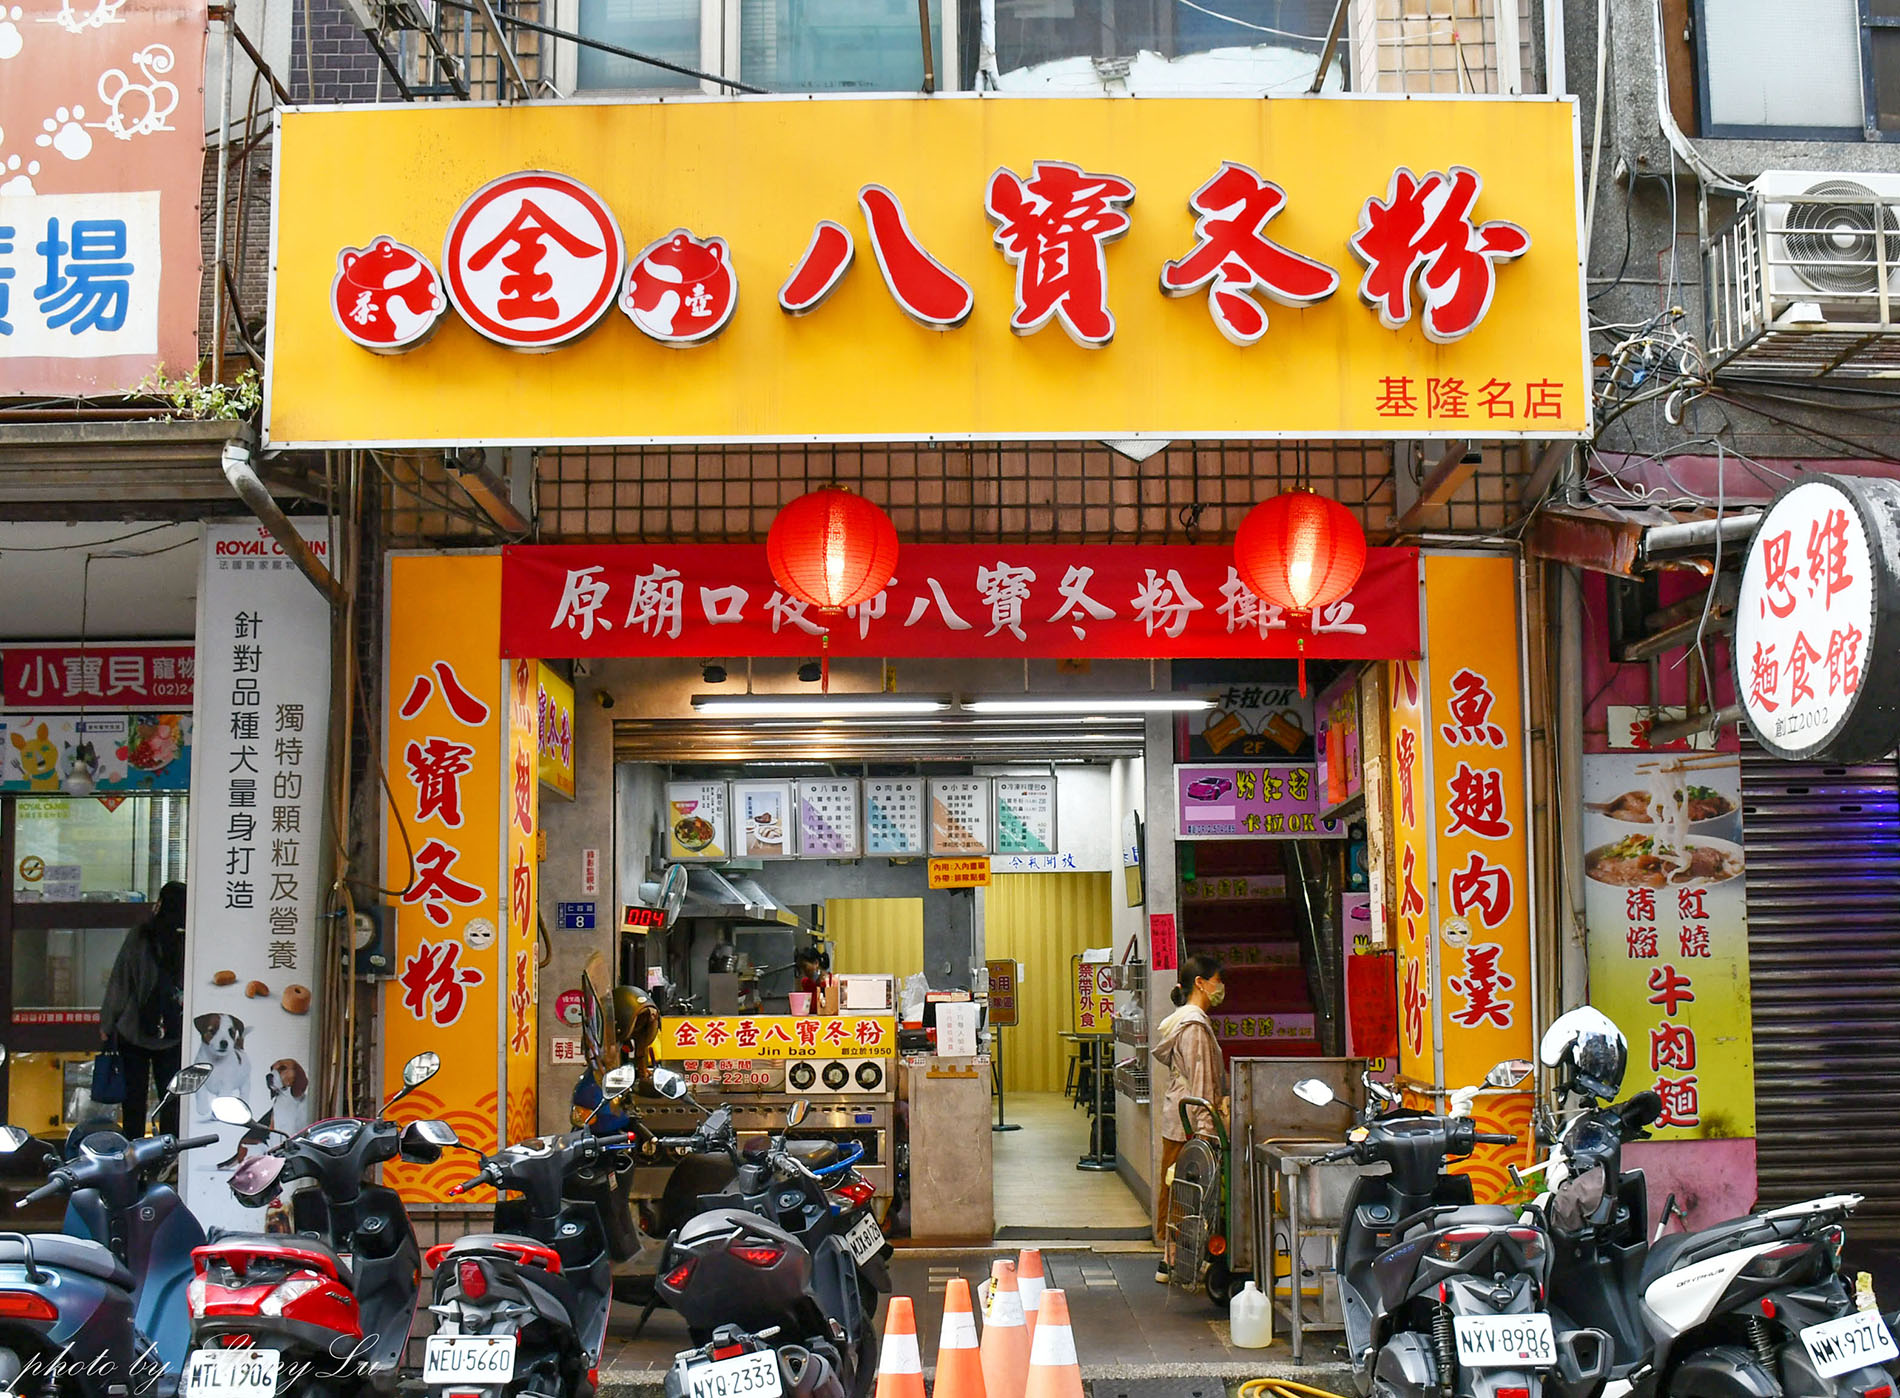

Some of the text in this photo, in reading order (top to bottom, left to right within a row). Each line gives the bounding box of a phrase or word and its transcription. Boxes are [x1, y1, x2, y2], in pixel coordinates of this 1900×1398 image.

[0, 217, 134, 336] 場
[777, 161, 1531, 346] 八寶冬粉
[349, 291, 378, 326] 茶
[1375, 375, 1564, 421] 基隆名店
[216, 541, 268, 555] ROYAL
[1760, 508, 1853, 619] 思維
[19, 656, 148, 697] 小寶貝
[1749, 622, 1862, 712] 麵食館
[1220, 687, 1295, 709] 卡拉OK
[225, 610, 263, 910] 針對品種犬量身打造
[1243, 742, 1265, 754] 2F
[1236, 768, 1318, 803] 粉紅超
[268, 704, 305, 970] 獨特的顆粒及營養
[400, 661, 490, 1027] 八寶冬粉
[1241, 814, 1316, 834] 卡拉OK
[1393, 660, 1426, 1057] 八寶冬粉
[1441, 668, 1515, 1029] 魚翅肉羹
[576, 915, 585, 928] 8
[627, 908, 665, 927] 004
[1678, 888, 1712, 958] 紅燒
[675, 1020, 885, 1047] 金茶壺八寶冬粉
[758, 1046, 817, 1056] Jin bao
[1648, 964, 1700, 1128] 牛肉麵
